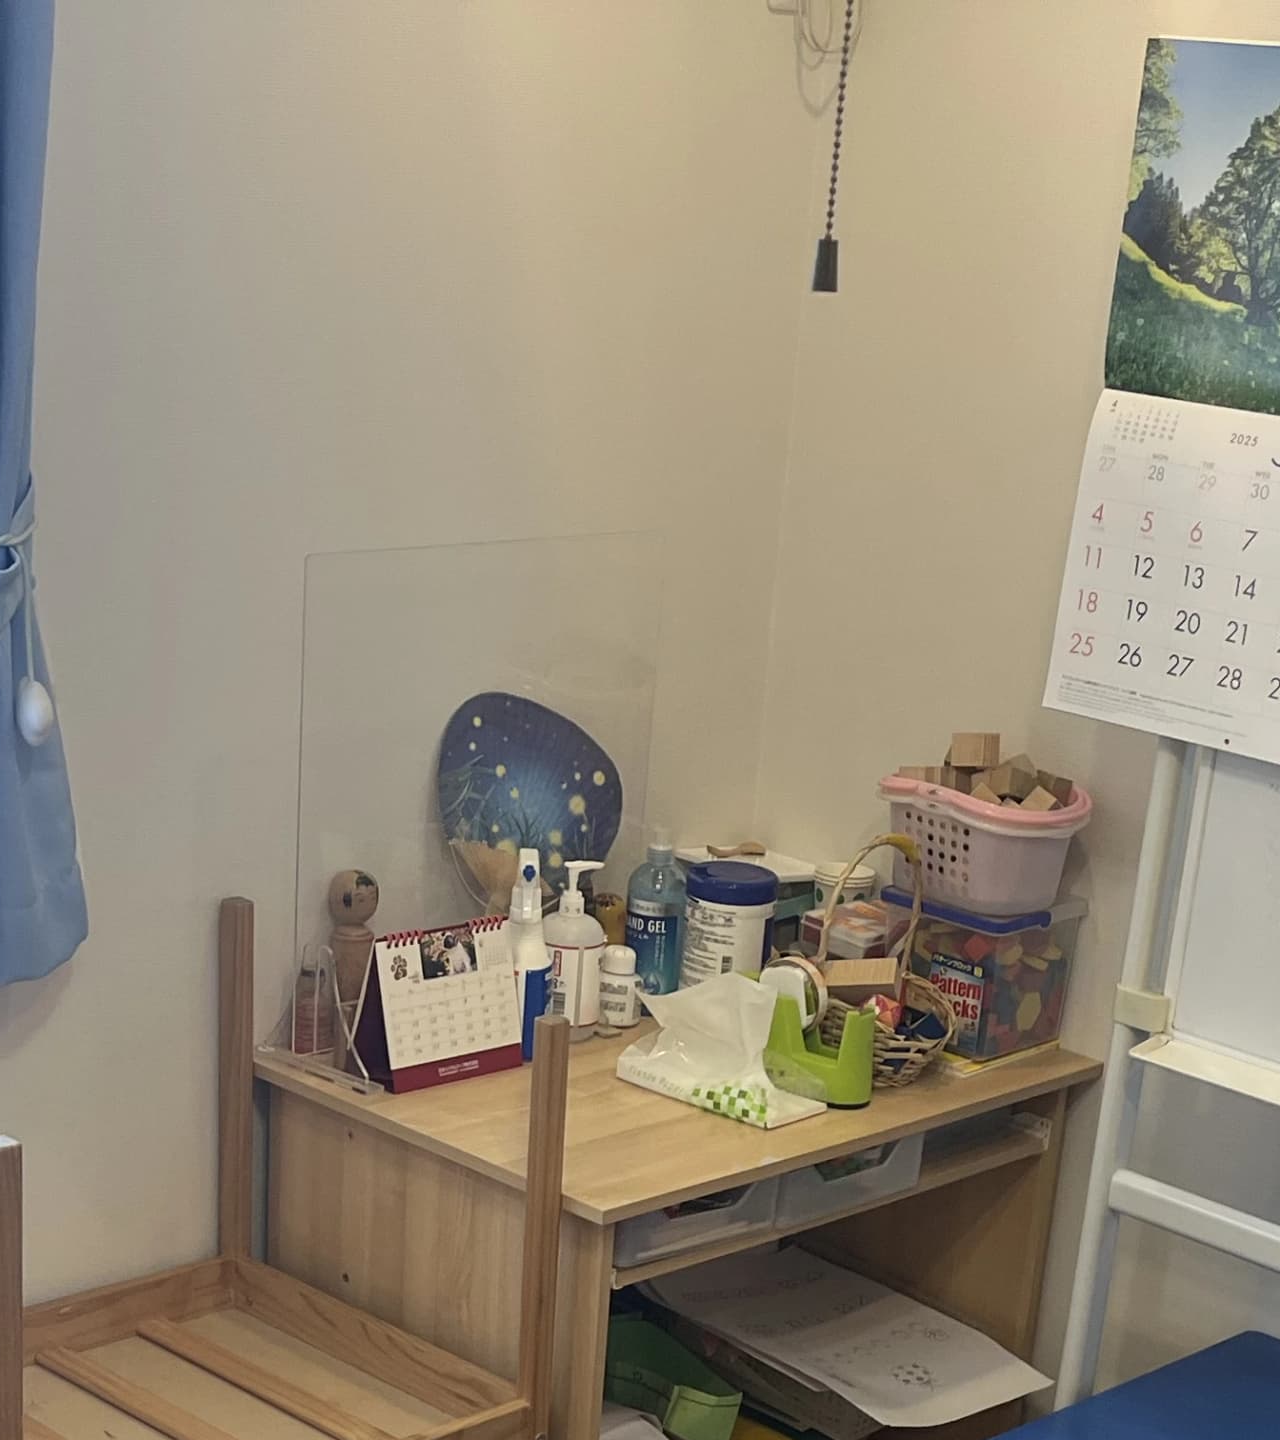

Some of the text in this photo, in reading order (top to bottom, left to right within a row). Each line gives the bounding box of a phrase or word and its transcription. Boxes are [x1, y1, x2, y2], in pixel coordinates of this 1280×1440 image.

[1230, 433, 1258, 447] 2025
[1098, 456, 1116, 472] 27
[1148, 465, 1165, 482] 28
[1198, 474, 1217, 491] 29
[1250, 483, 1270, 501] 30
[1092, 503, 1104, 524] 4
[1140, 511, 1154, 533] 5
[1189, 521, 1203, 543] 6
[1242, 529, 1258, 552] 7
[1085, 544, 1103, 569] 11
[1133, 555, 1155, 579] 12
[1184, 564, 1205, 590] 13
[1234, 575, 1257, 600] 14
[1077, 588, 1099, 614] 18
[1126, 599, 1149, 623] 19
[1174, 610, 1201, 635] 20
[1224, 620, 1248, 646] 21
[1069, 632, 1095, 657] 25
[1117, 643, 1142, 668] 26
[1166, 653, 1195, 677] 27
[1216, 665, 1243, 691] 28
[628, 916, 667, 934] AND GEL
[930, 973, 981, 1001] Pattern
[950, 999, 979, 1020] cks
